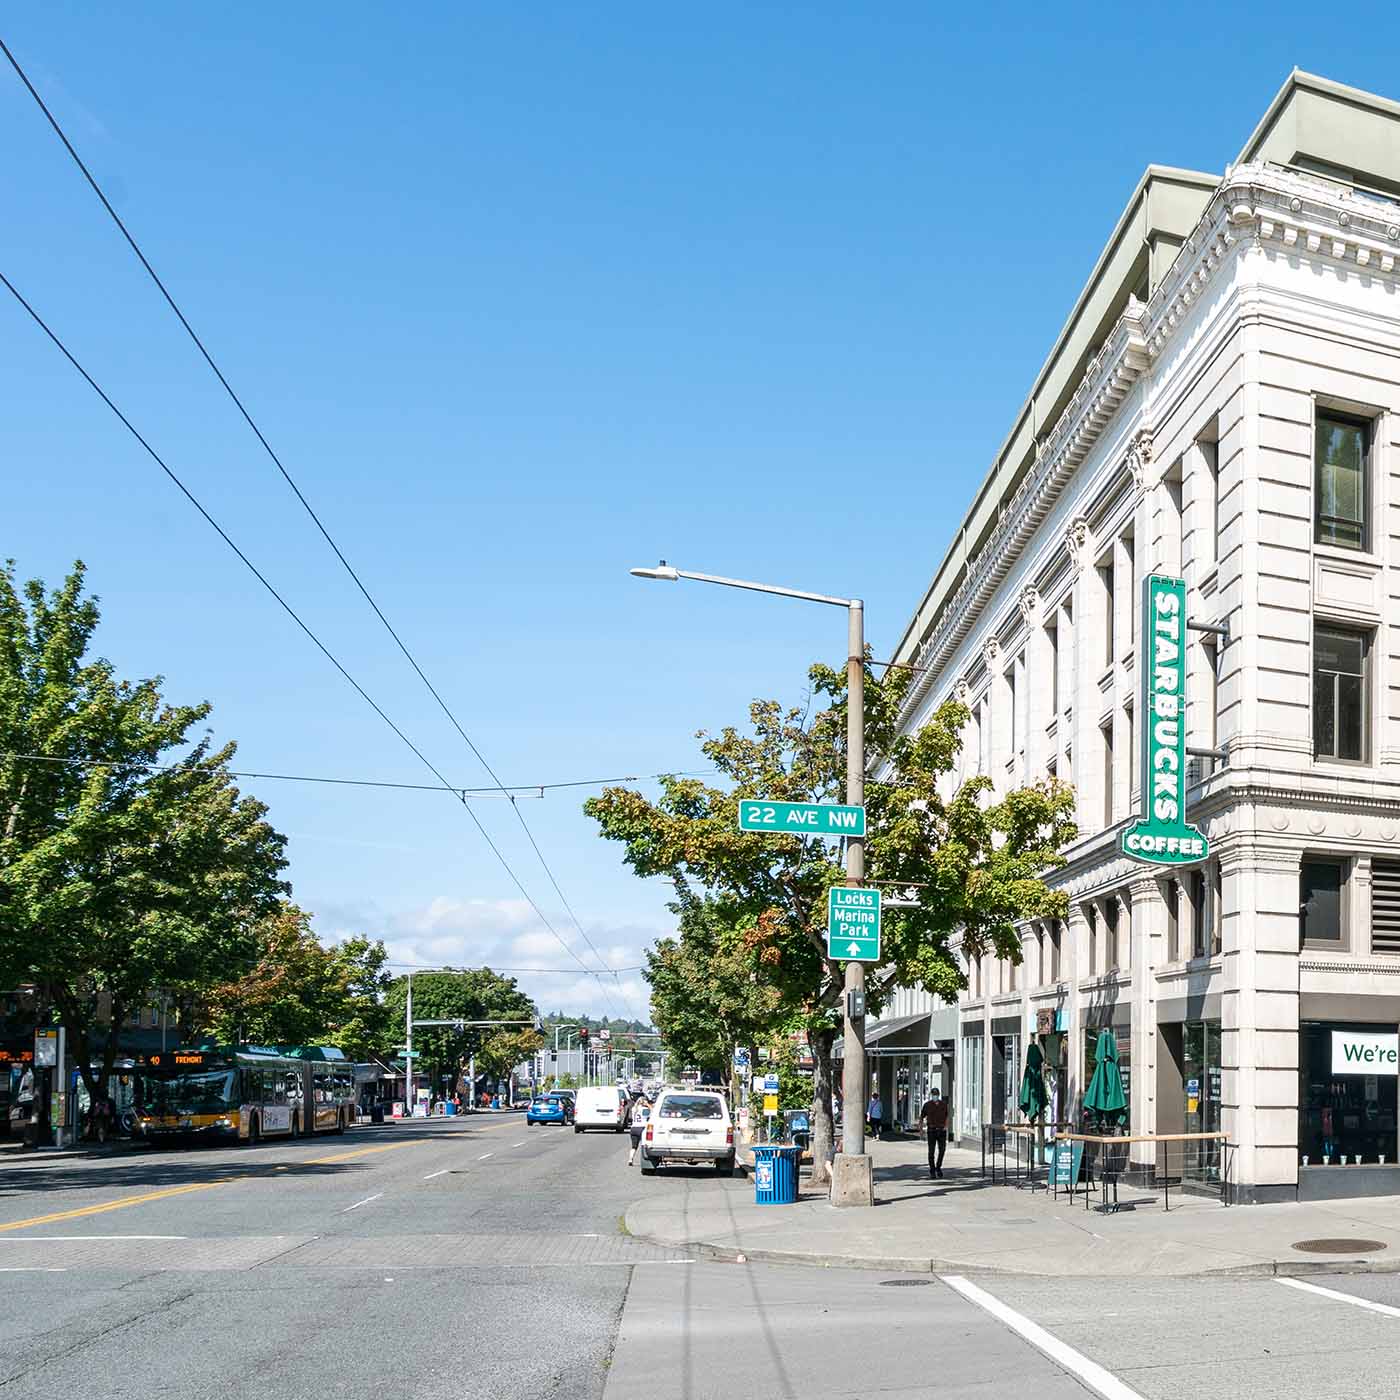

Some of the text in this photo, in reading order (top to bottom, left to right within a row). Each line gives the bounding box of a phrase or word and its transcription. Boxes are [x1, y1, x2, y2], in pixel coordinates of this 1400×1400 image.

[1154, 591, 1180, 822] STARBUCKS
[747, 807, 857, 828] 22 AVE NW
[1126, 835, 1204, 856] COFFEE
[836, 893, 873, 906] Locks
[834, 909, 875, 924] Marina
[839, 924, 869, 937] Park
[175, 1055, 203, 1064] FREMONT
[1344, 1044, 1397, 1063] We're
